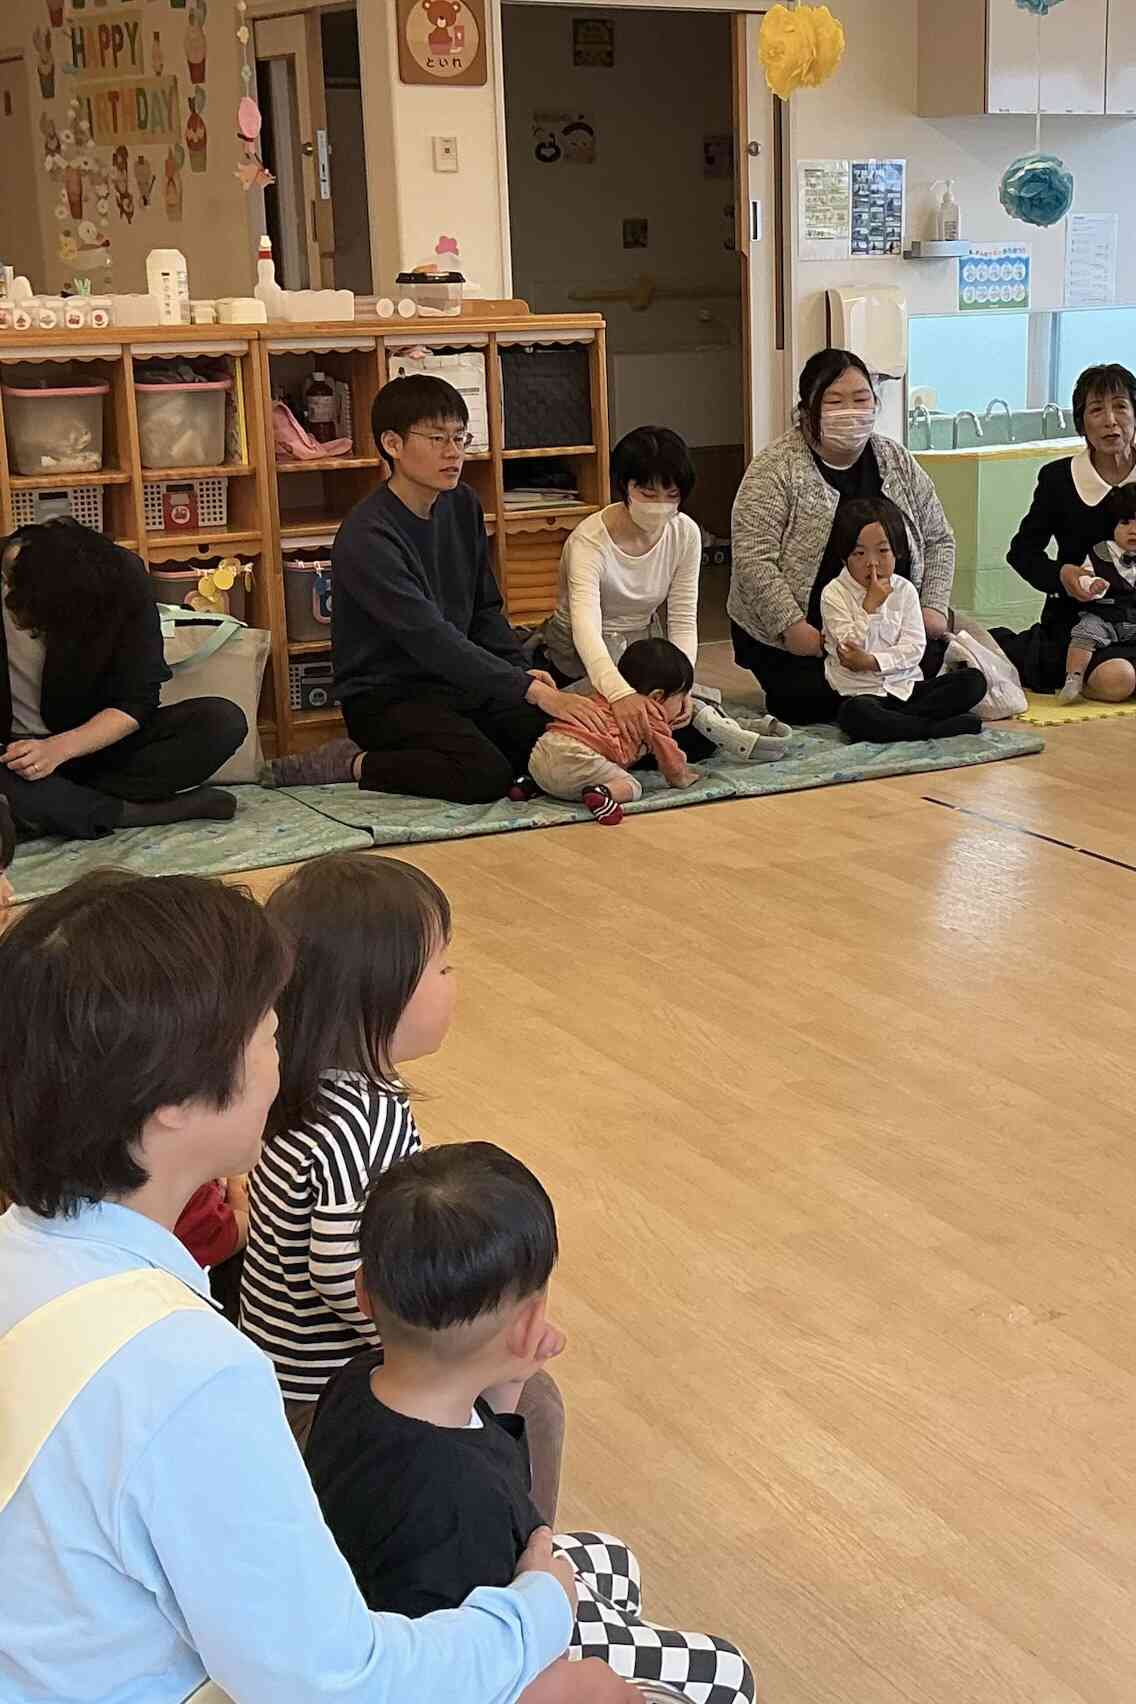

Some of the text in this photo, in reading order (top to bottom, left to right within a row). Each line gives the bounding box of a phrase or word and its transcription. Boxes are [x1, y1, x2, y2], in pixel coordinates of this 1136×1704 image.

[71, 21, 139, 68] HAPPY
[426, 57, 462, 68] といれ
